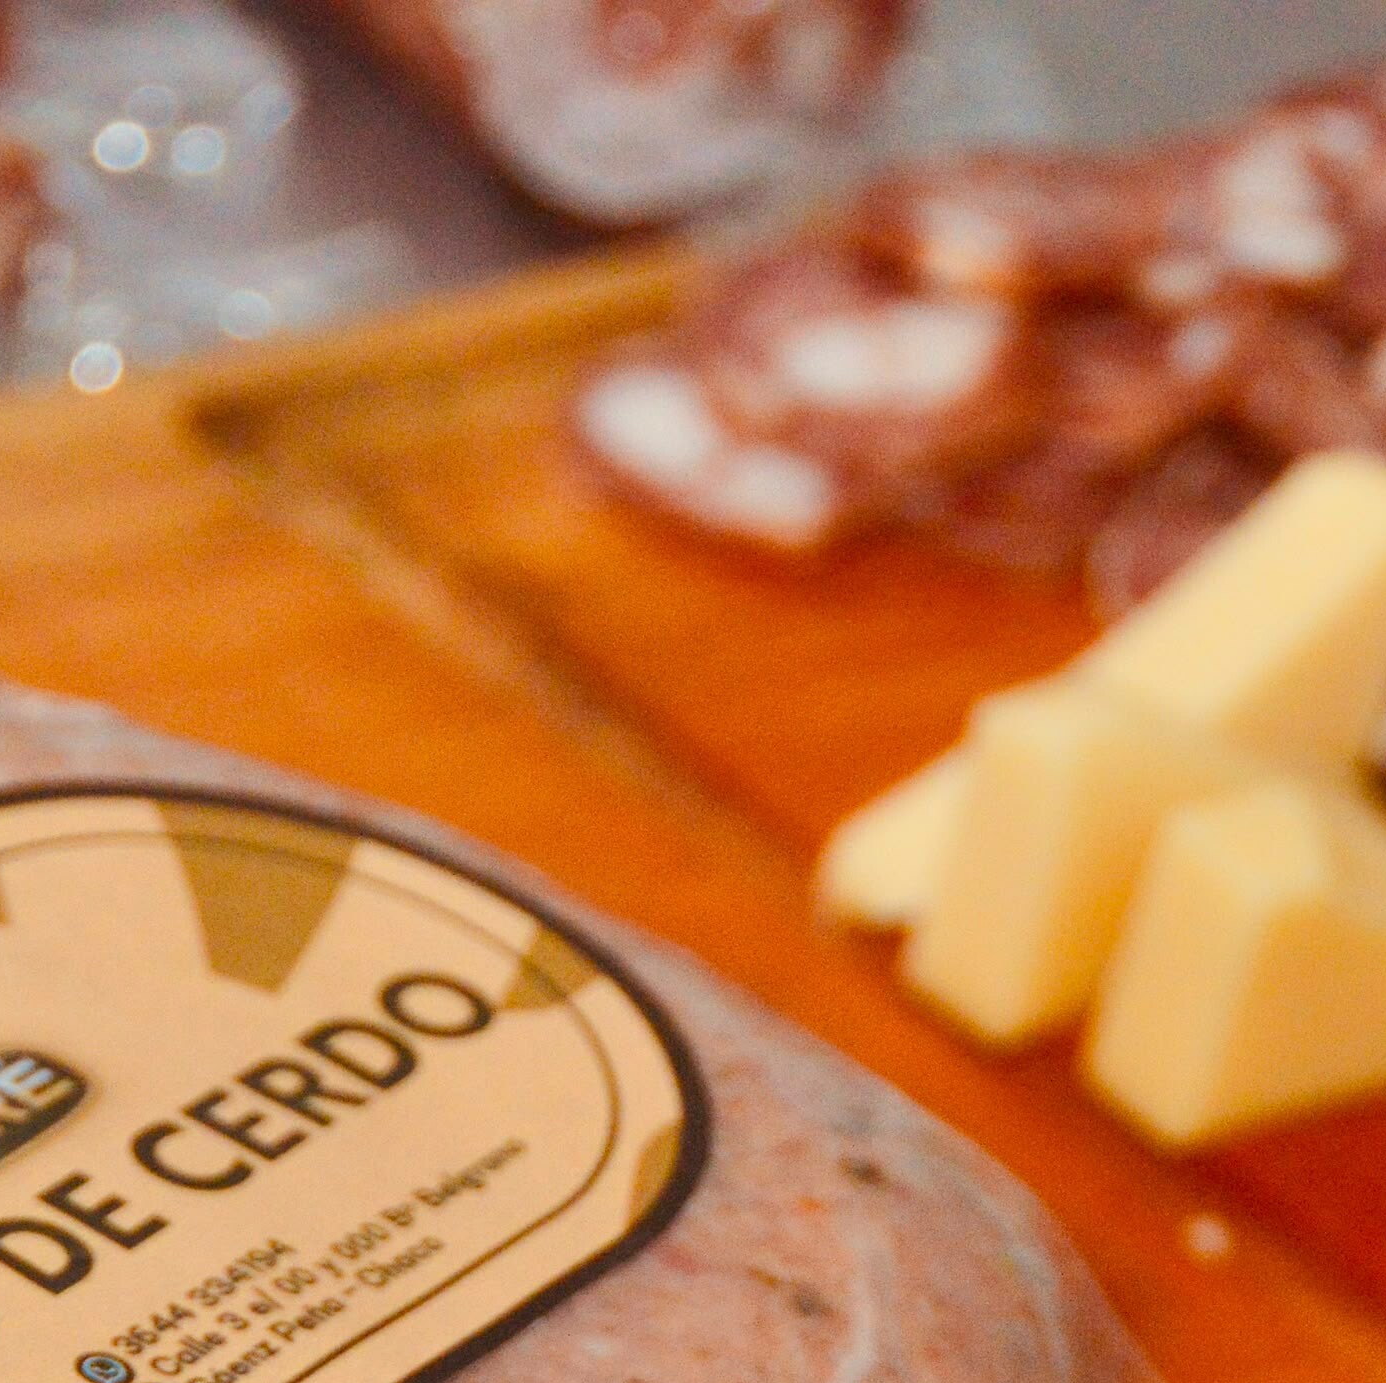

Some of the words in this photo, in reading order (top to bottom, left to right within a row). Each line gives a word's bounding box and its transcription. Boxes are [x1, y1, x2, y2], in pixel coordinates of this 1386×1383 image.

[130, 972, 495, 1193] CERDO
[149, 1332, 227, 1377] Calle
[215, 1311, 250, 1331] 3
